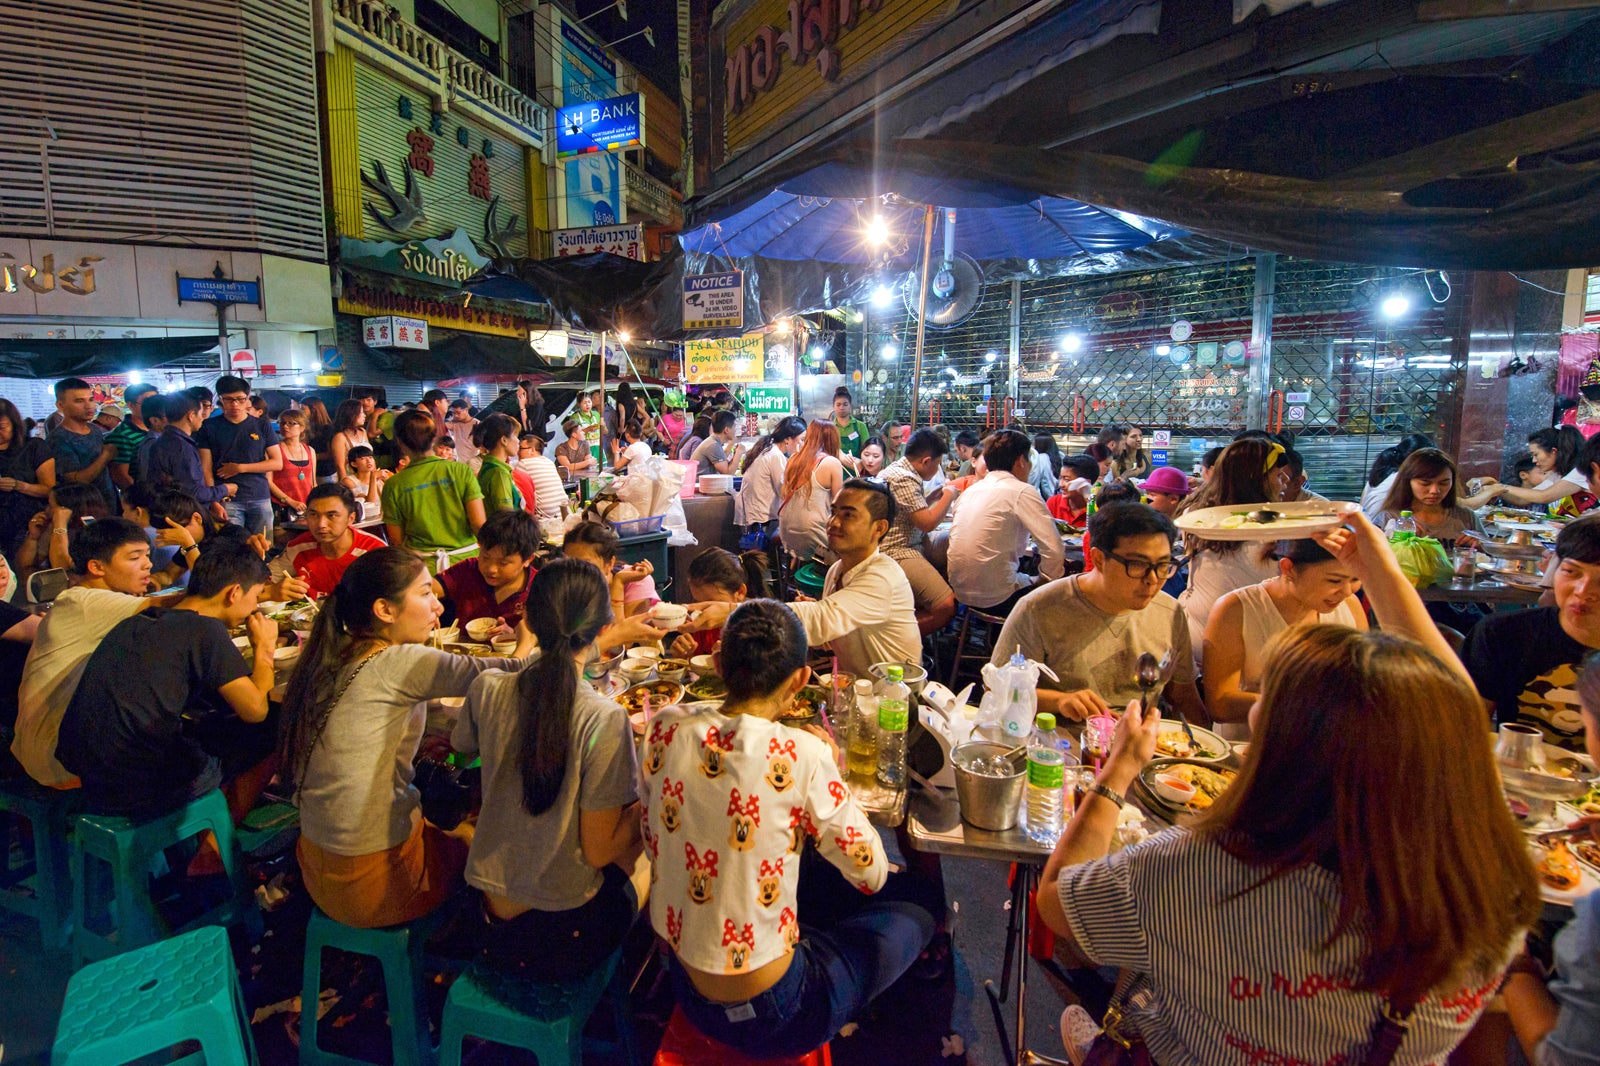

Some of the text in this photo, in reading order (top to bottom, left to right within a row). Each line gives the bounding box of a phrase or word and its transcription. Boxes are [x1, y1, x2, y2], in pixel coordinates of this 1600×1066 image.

[565, 101, 636, 128] LH BANK
[691, 275, 733, 289] NOTICE
[716, 339, 759, 349] SEAFOOD
[746, 389, 788, 409] ไม่มีสาขา
